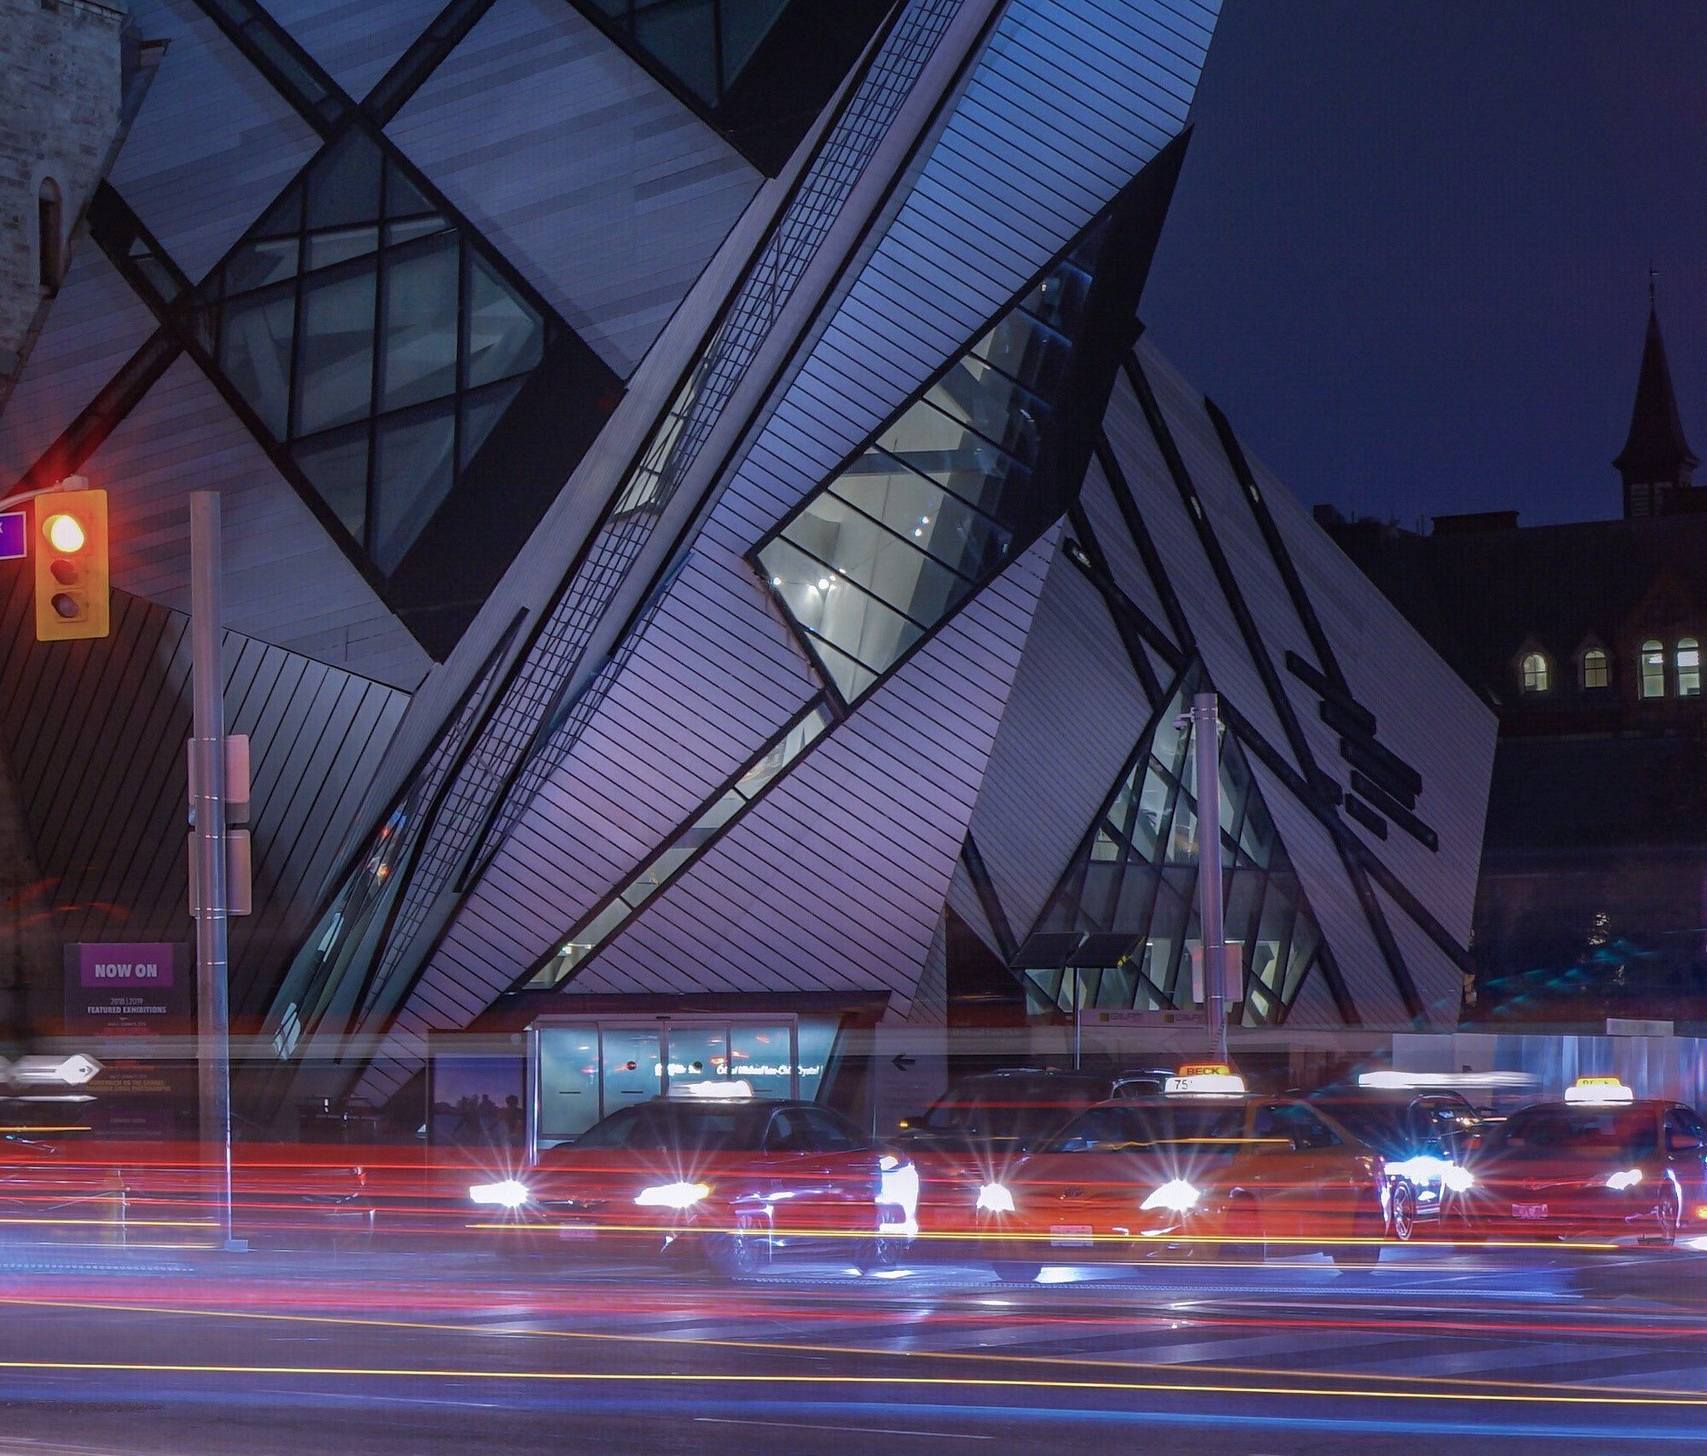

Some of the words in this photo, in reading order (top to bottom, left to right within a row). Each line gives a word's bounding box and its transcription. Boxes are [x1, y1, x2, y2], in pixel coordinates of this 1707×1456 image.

[94, 964, 132, 978] NOW
[134, 964, 158, 978] ON
[87, 1006, 122, 1014] FEATURED
[123, 1006, 166, 1014] EXHIBITIONS
[1187, 1067, 1220, 1075] BECK
